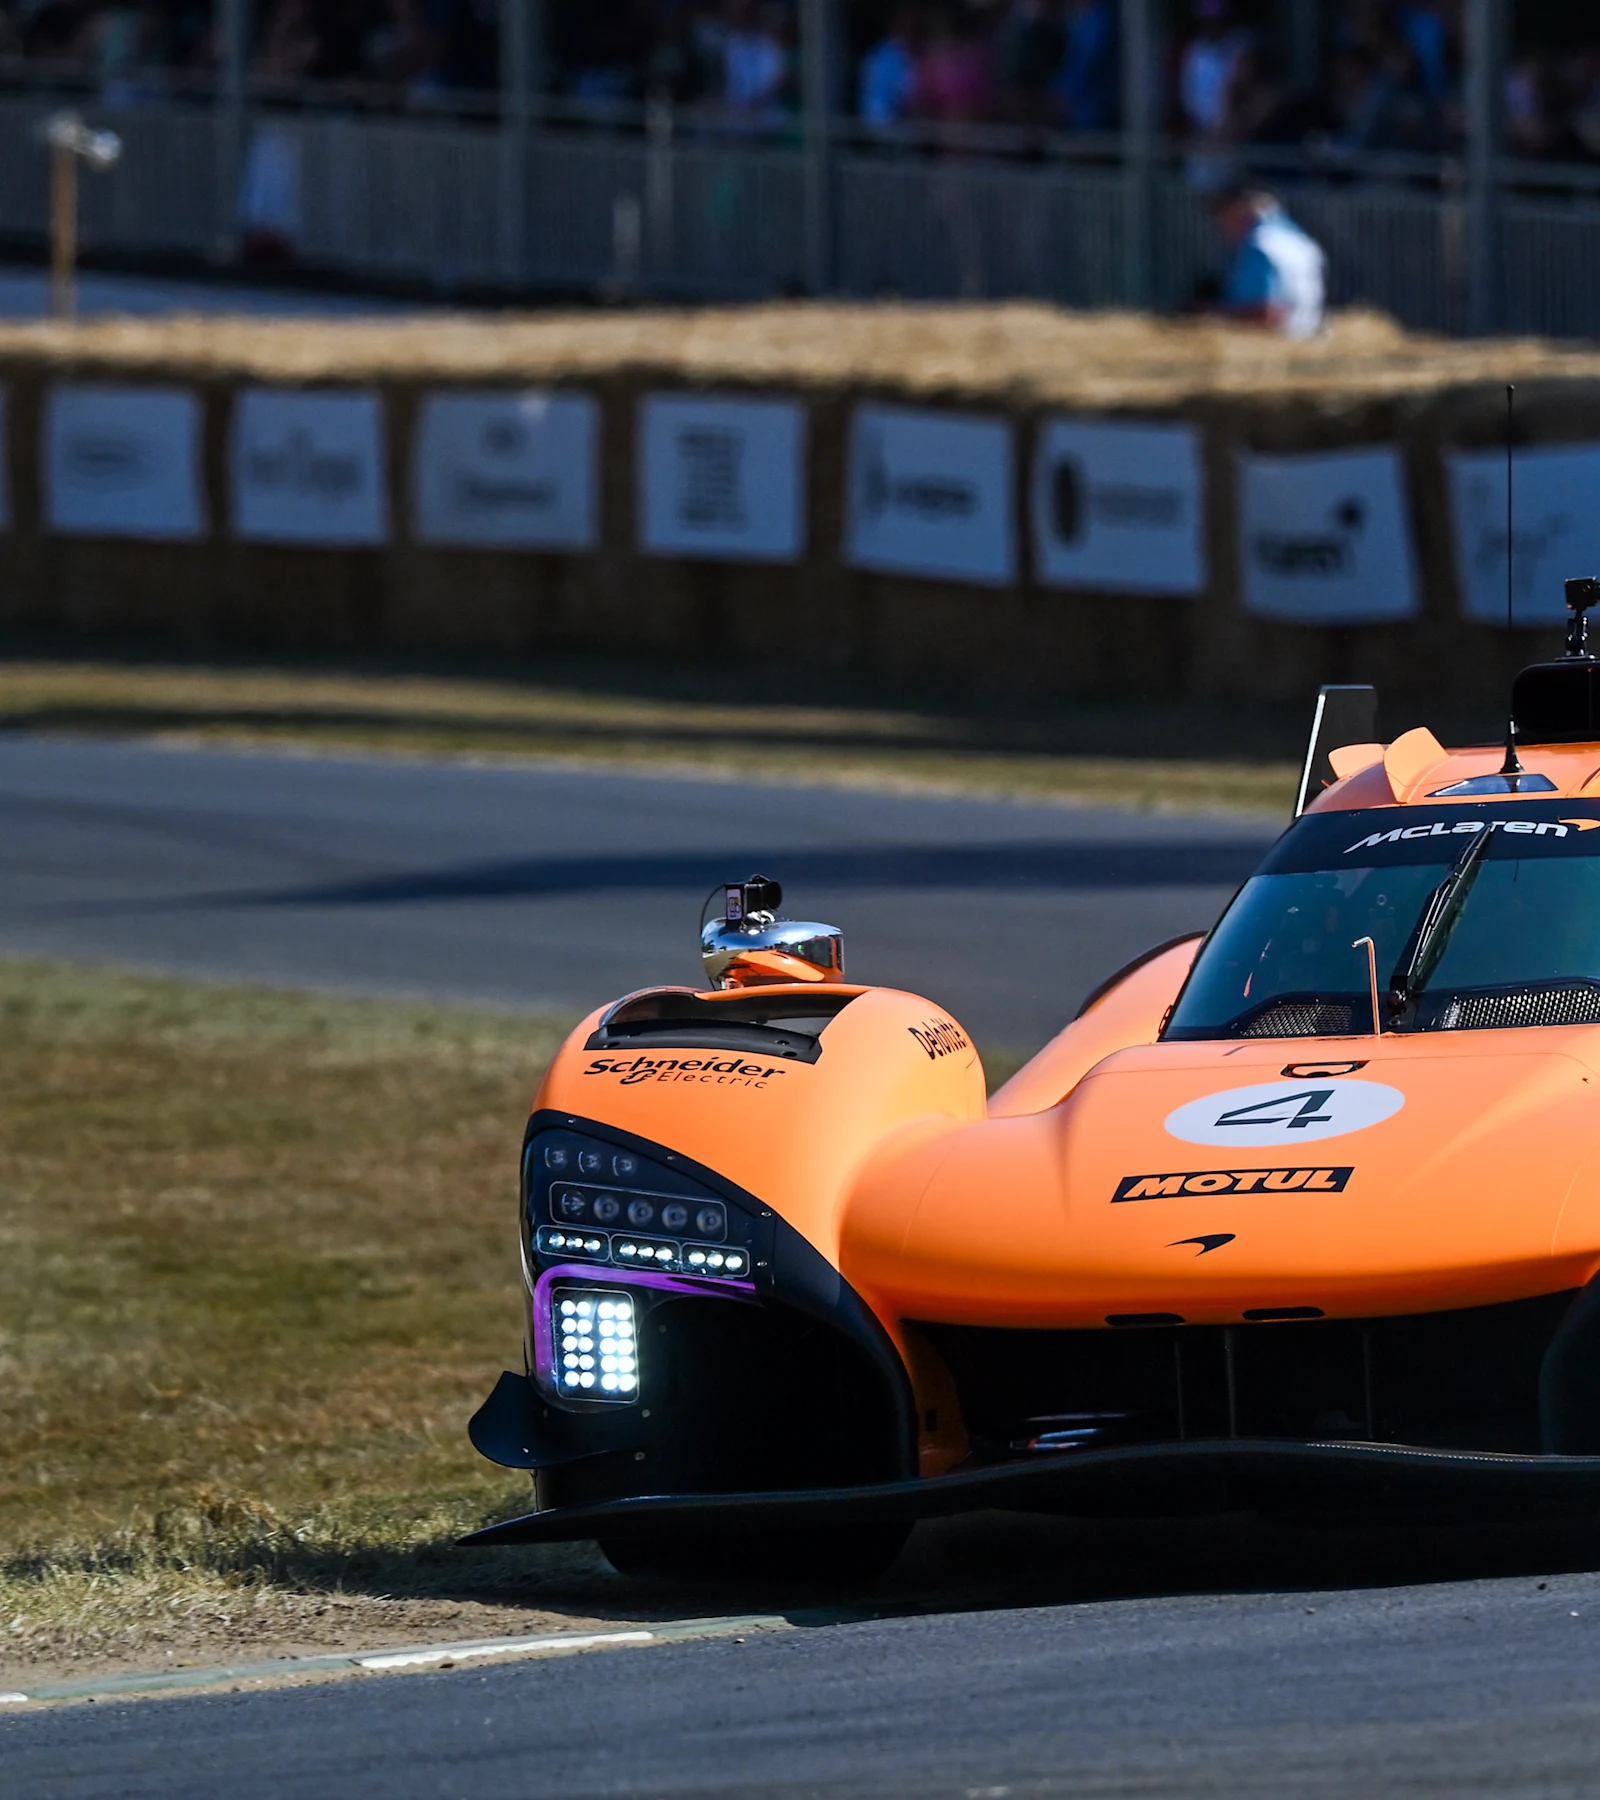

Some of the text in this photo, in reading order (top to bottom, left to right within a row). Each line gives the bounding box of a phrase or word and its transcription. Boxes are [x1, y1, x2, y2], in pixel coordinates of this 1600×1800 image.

[583, 1056, 786, 1079] Schneider
[656, 1071, 768, 1089] Electric
[1214, 1089, 1335, 1128] 4
[1122, 1169, 1338, 1198] MOTUL
